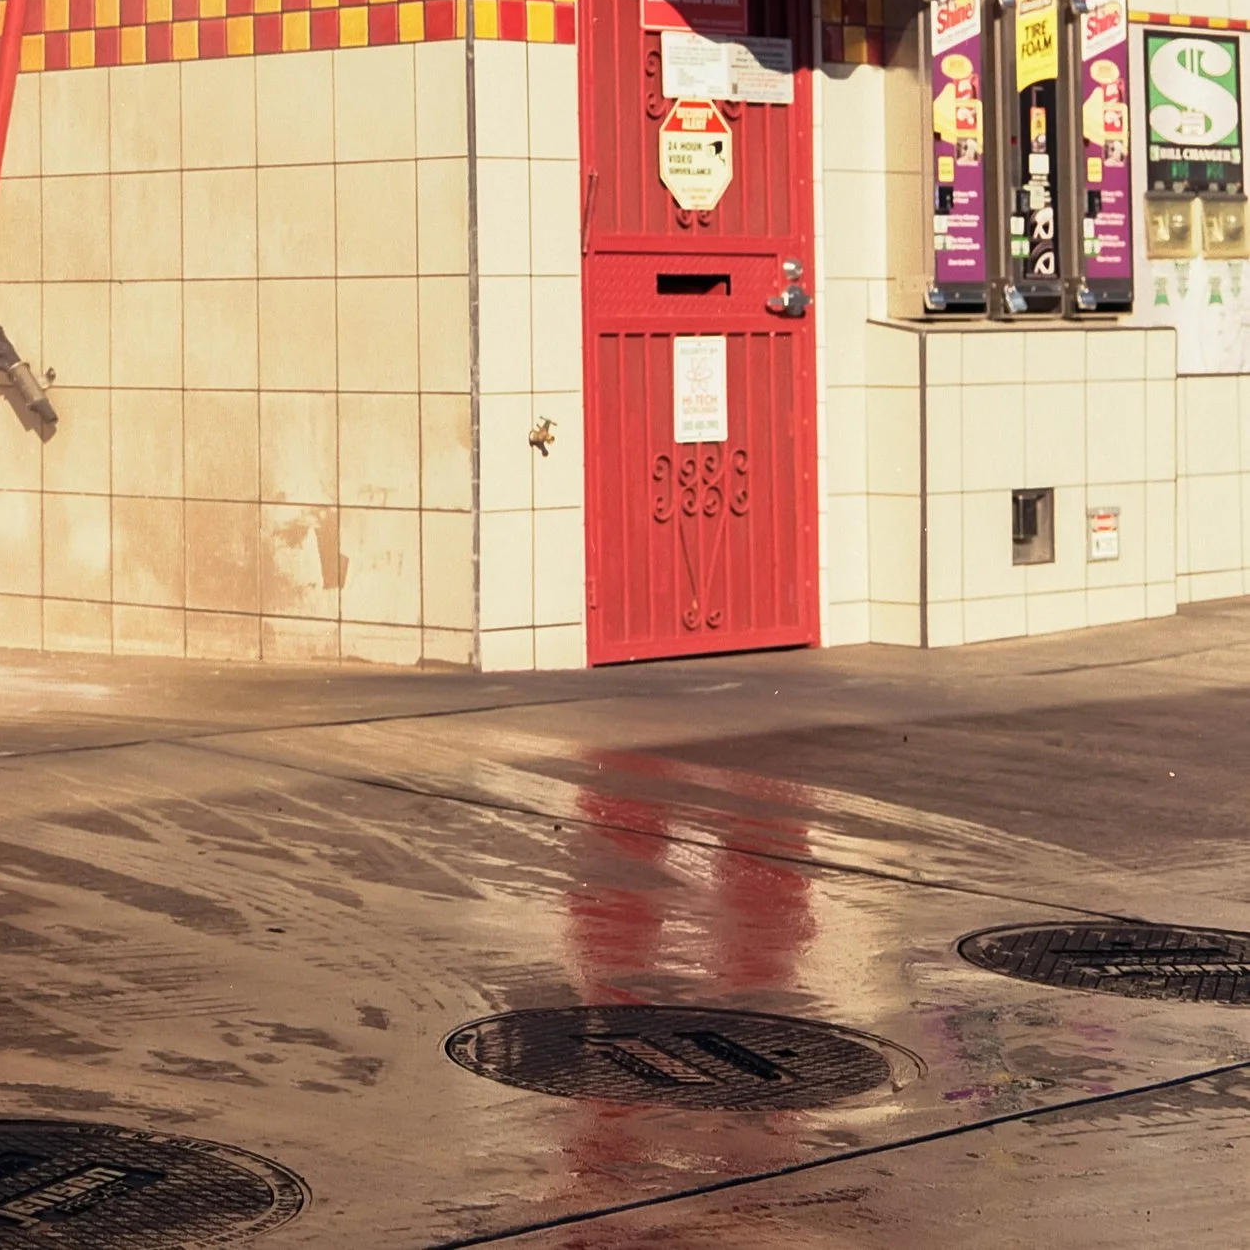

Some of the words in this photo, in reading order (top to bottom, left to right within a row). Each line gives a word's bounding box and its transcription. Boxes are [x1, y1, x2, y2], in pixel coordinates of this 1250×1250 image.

[1025, 19, 1048, 41] TIRE
[1021, 35, 1052, 61] FOAM
[668, 141, 677, 151] 24
[680, 142, 703, 152] HOUR
[669, 154, 692, 164] VIDEO
